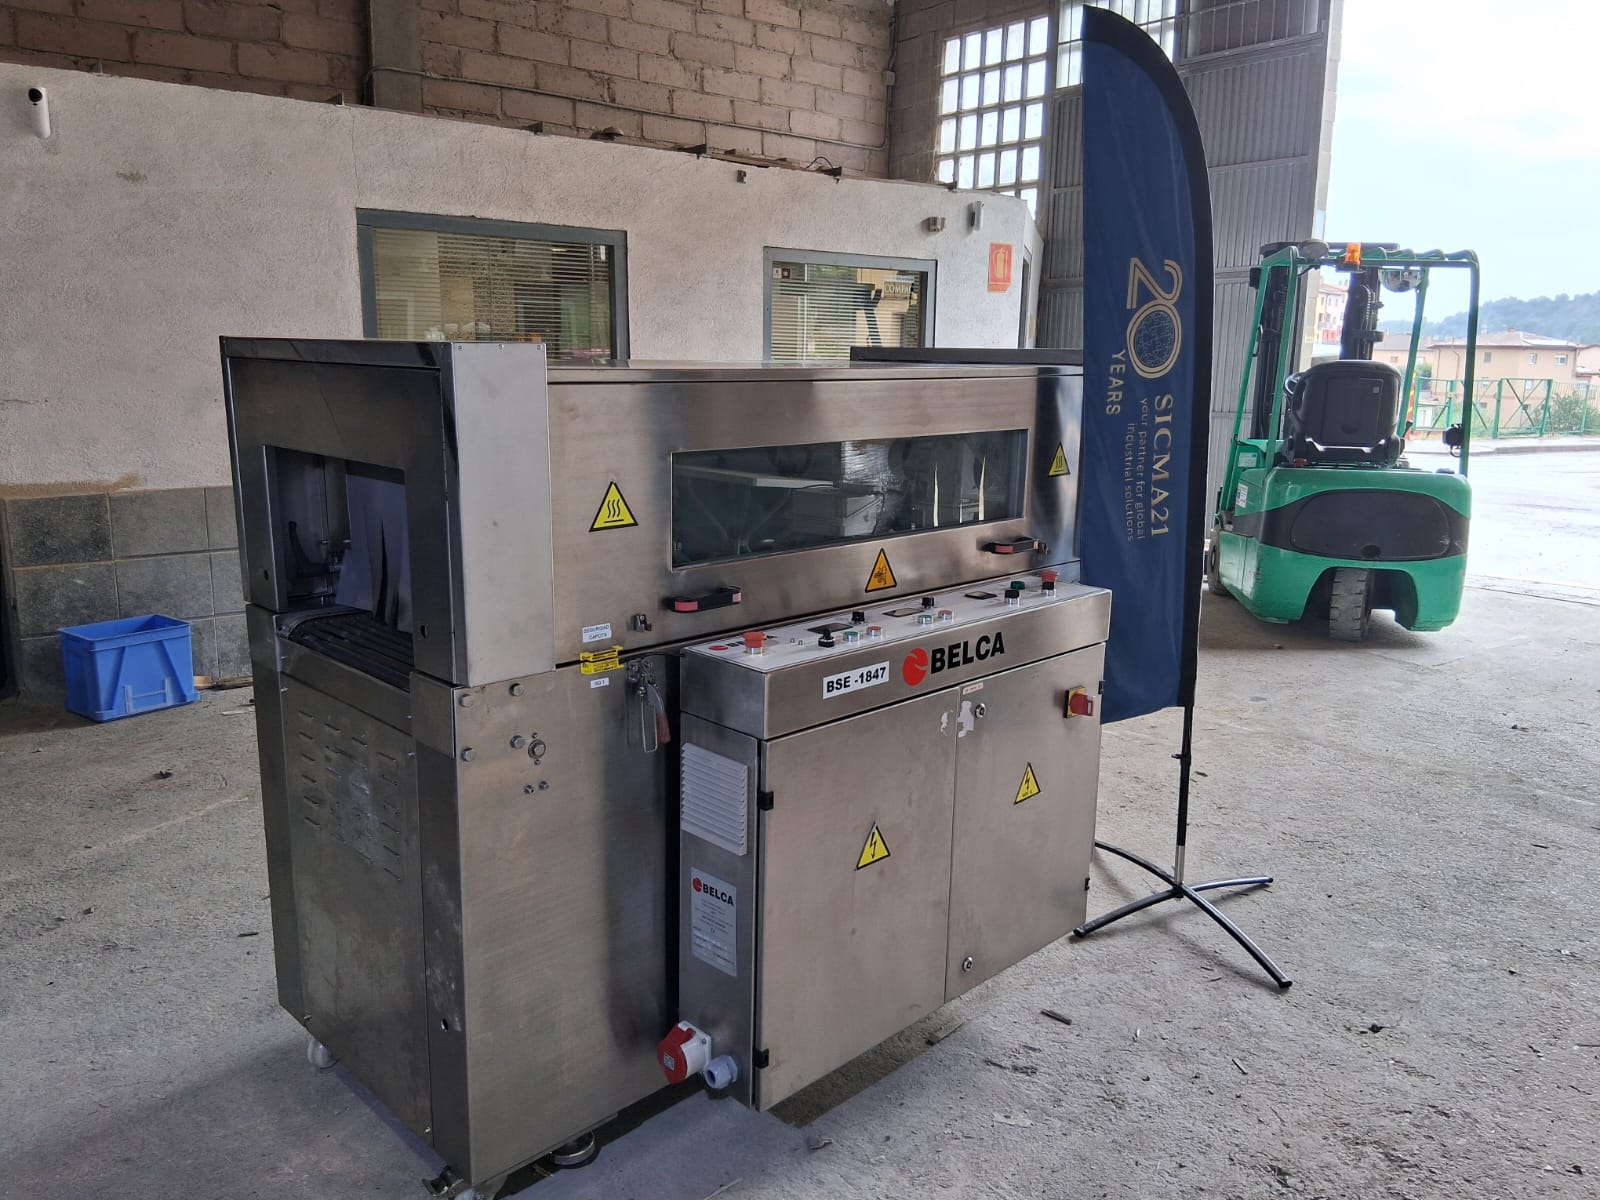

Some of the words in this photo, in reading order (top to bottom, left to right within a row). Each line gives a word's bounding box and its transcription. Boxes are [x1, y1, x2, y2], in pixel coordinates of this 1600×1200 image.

[1126, 257, 1183, 378] 20
[1106, 349, 1126, 415] YEARS
[1139, 397, 1151, 427] your
[1123, 422, 1138, 481] industrial
[1136, 430, 1148, 477] partner
[1152, 394, 1174, 536] SICMA21
[1135, 480, 1146, 498] for
[1123, 485, 1135, 542] solutions
[1134, 501, 1145, 540] global
[930, 631, 1006, 675] BELCA
[826, 675, 851, 694] BSE
[702, 883, 734, 906] BELCA
